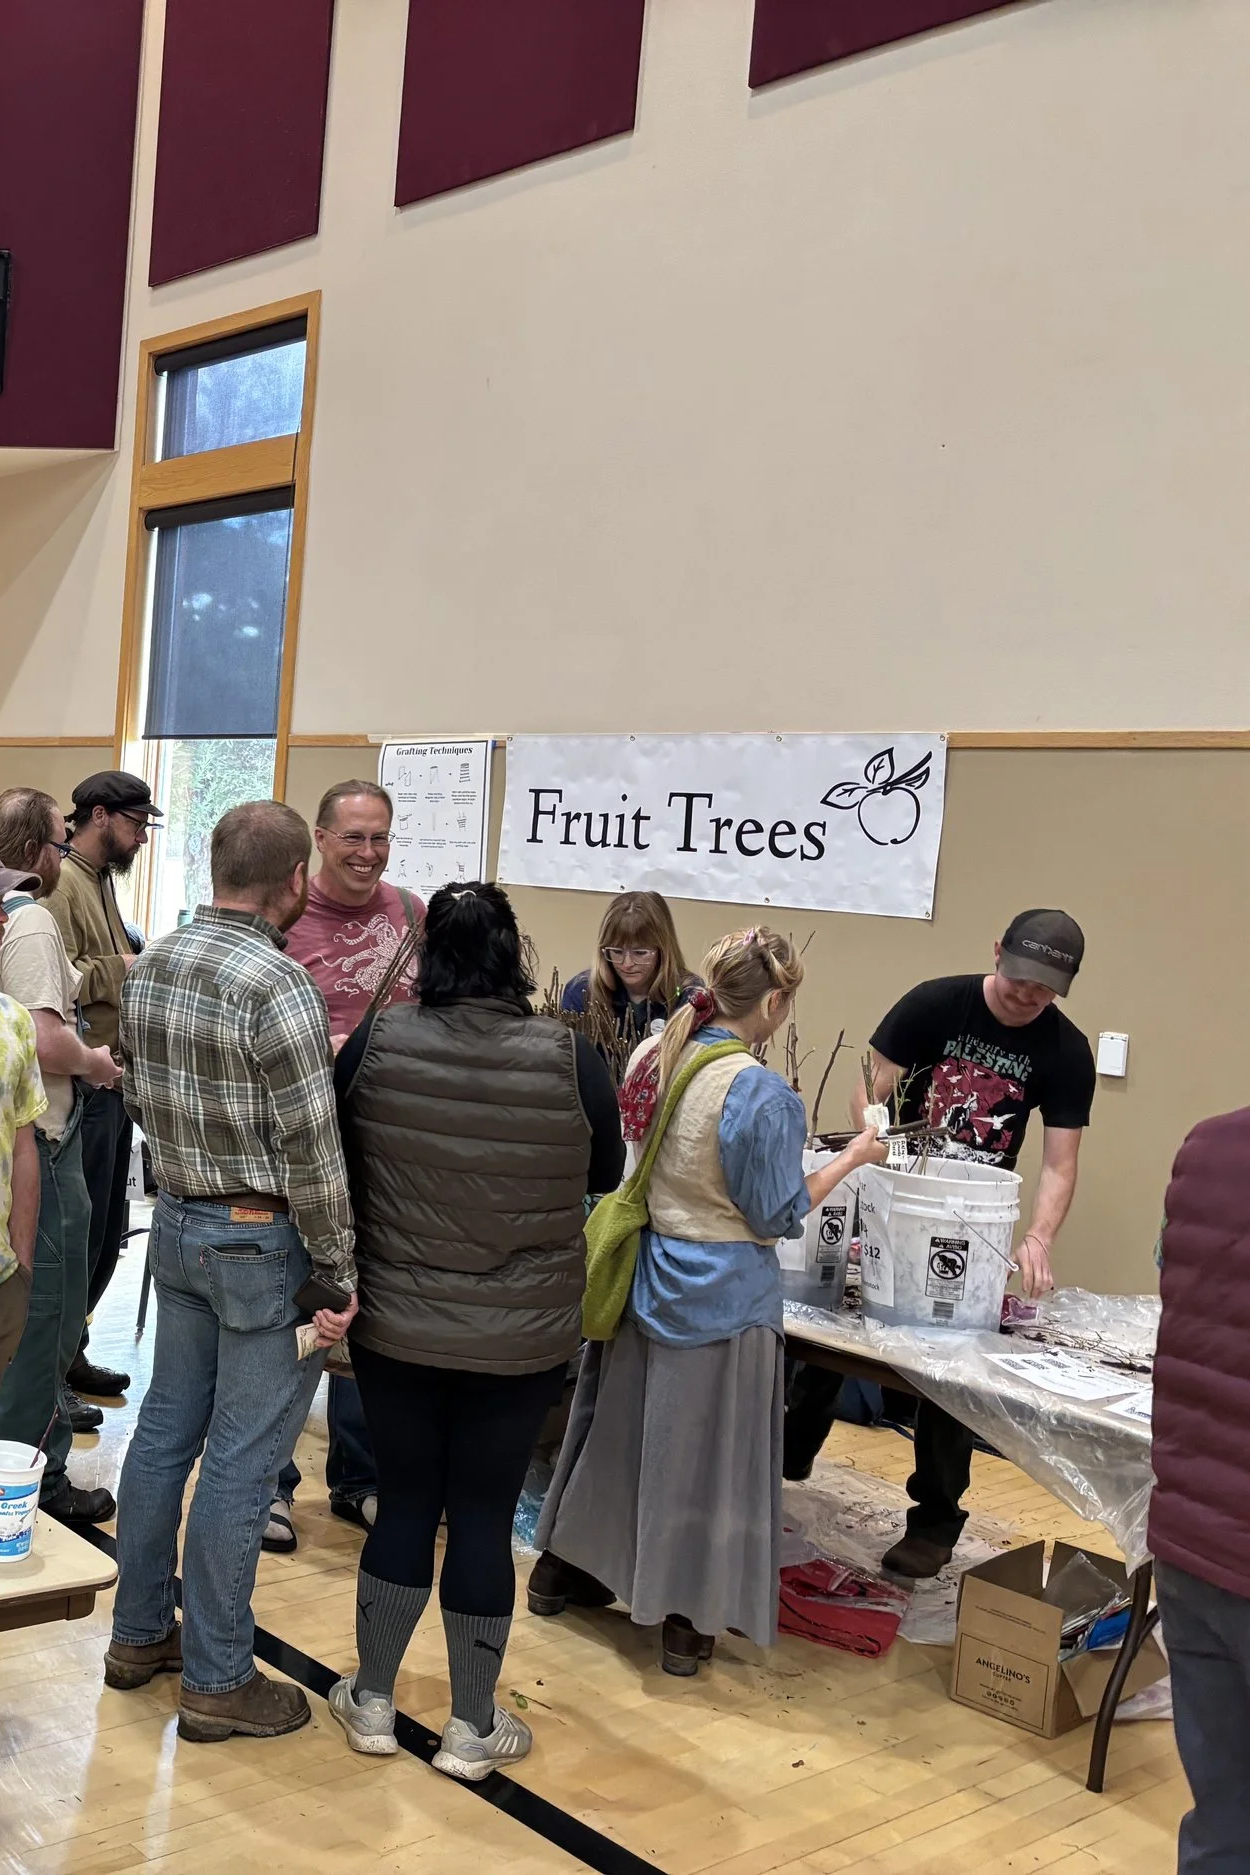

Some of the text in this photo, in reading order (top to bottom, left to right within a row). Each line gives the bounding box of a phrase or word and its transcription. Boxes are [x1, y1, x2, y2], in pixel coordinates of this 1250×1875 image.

[396, 746, 473, 756] Grafting Techniques
[526, 788, 827, 861] Fruit Trees
[0, 1501, 29, 1510] Greek
[975, 1657, 1031, 1684] ANGELINO'S
